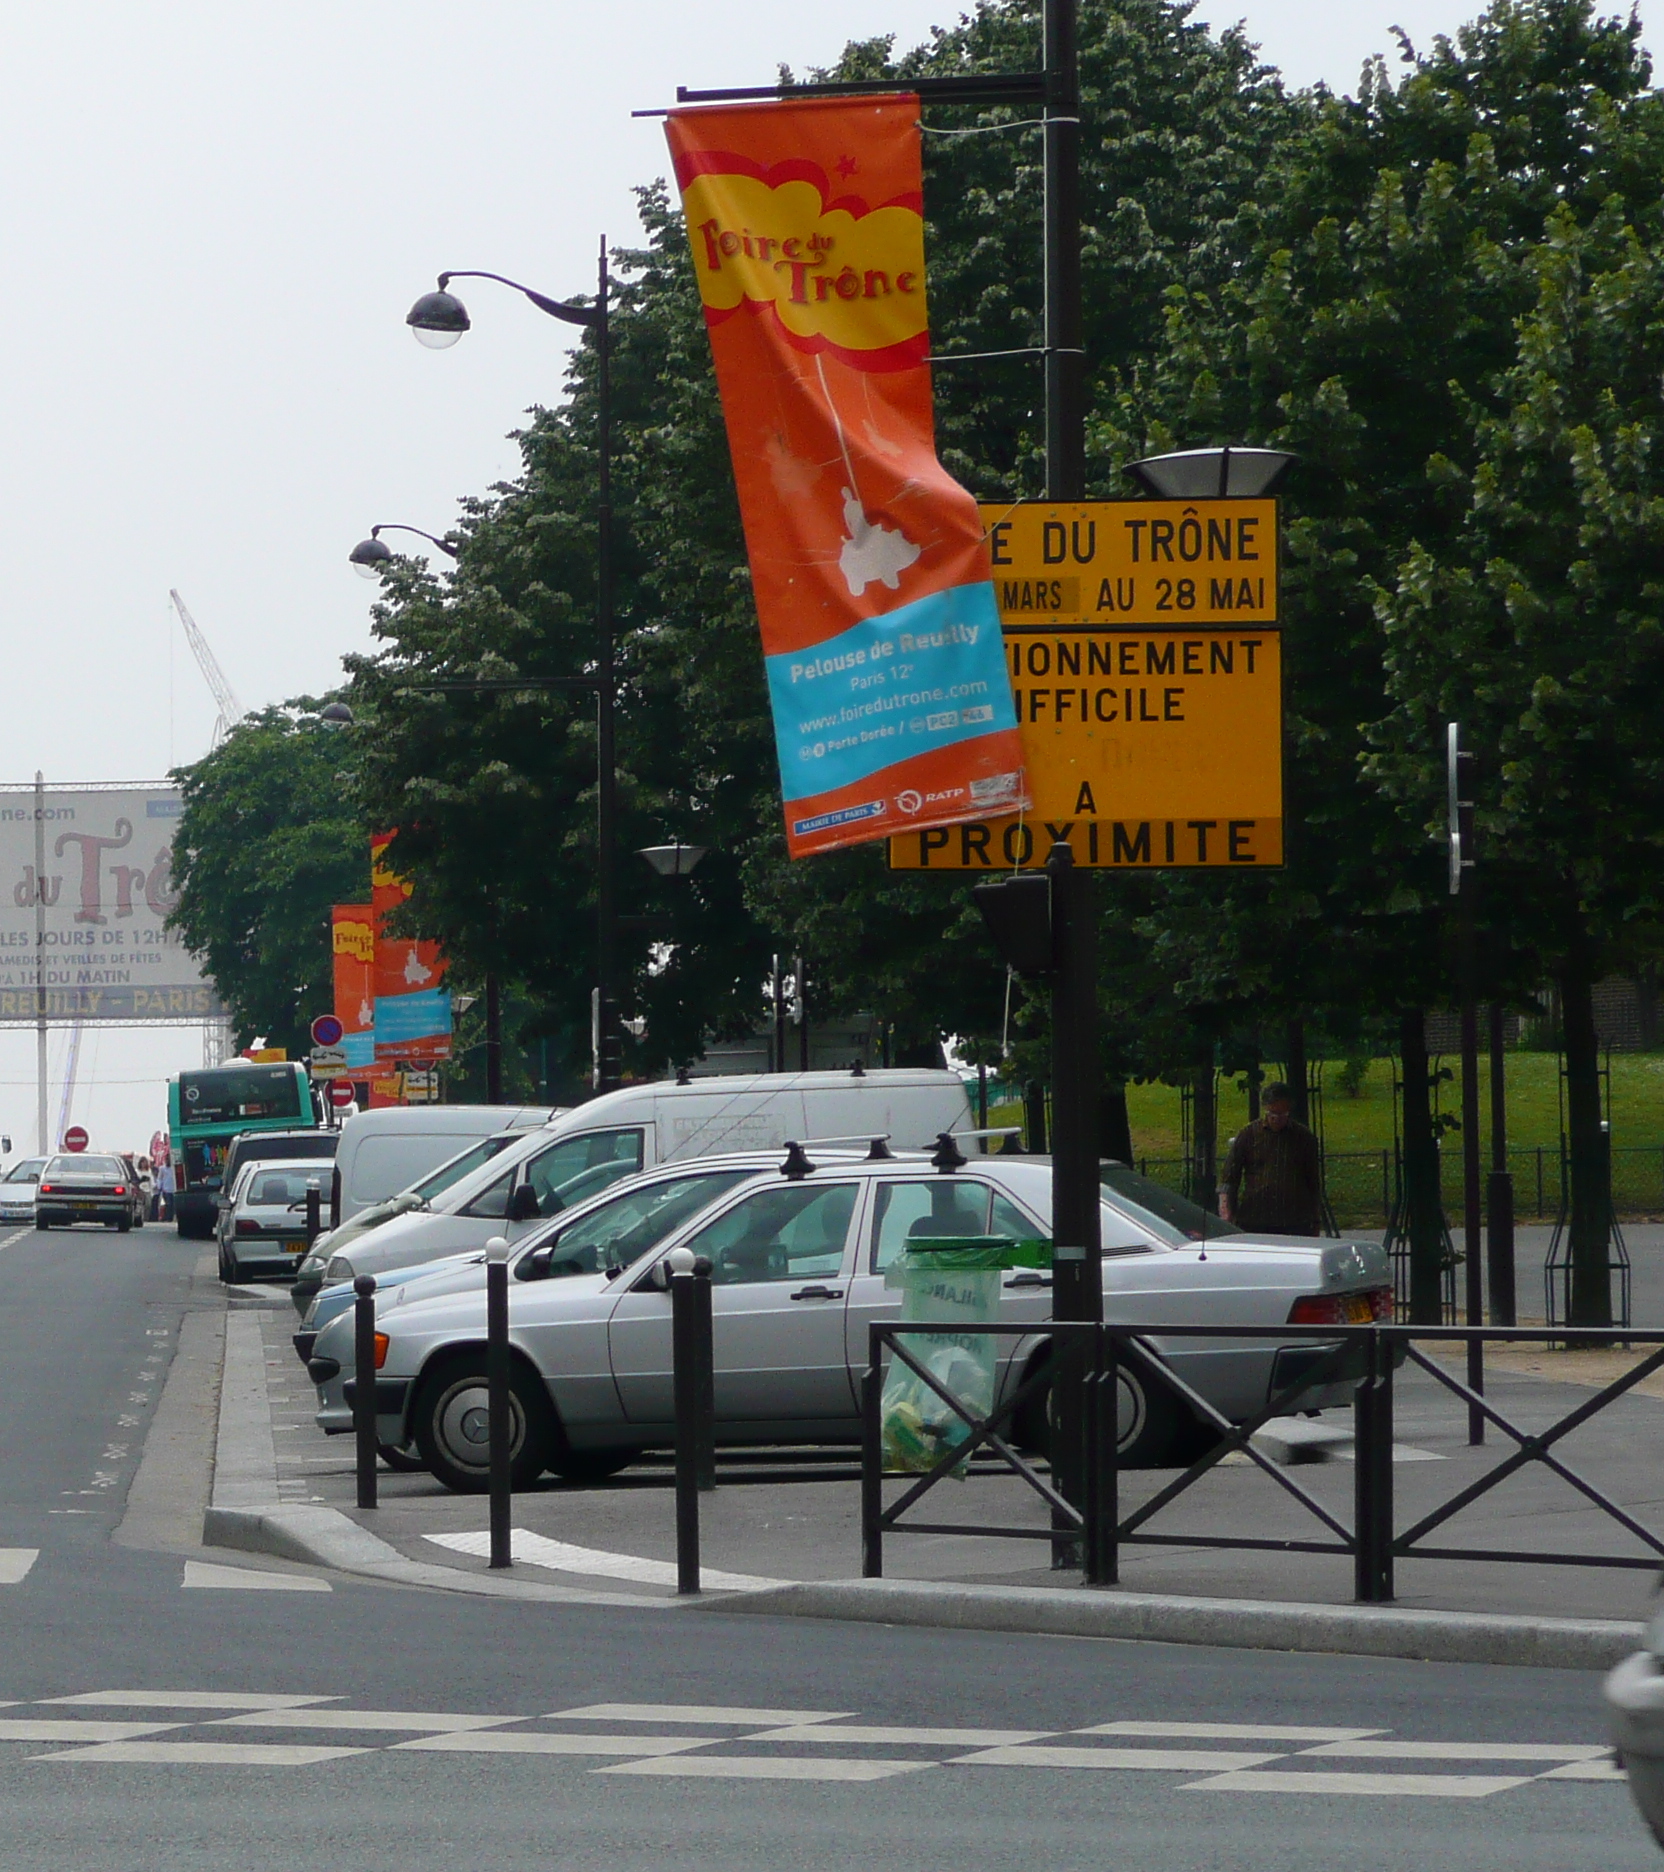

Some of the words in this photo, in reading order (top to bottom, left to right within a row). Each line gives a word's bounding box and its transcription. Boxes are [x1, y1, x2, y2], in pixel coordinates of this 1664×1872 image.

[697, 218, 800, 271] Foire
[806, 231, 834, 251] du
[773, 252, 915, 305] Trône
[984, 522, 1013, 565] E
[1042, 519, 1096, 565] DU
[1124, 507, 1259, 562] TRÔNE
[1003, 580, 1062, 611] MARS
[1096, 577, 1134, 611] AU
[1156, 577, 1196, 611] 28
[1209, 576, 1265, 610] MAI
[789, 648, 866, 684] Pelouse
[870, 640, 894, 661] de
[898, 623, 980, 653] Reuilly
[1004, 640, 1263, 677] IONNEMENT
[850, 672, 885, 691] Paris
[798, 679, 988, 734] www.foiredutrone.com
[828, 735, 859, 752] Porte
[925, 788, 964, 802] RATP
[1074, 781, 1097, 815] A
[802, 815, 830, 830] MAIRIE
[831, 813, 843, 824] DE
[845, 808, 869, 820] PARIS
[919, 820, 1257, 867] PROXIMITE
[13, 865, 64, 907] du
[0, 931, 29, 947] LES
[36, 930, 96, 946] JOURS
[101, 930, 124, 945] DE
[132, 929, 168, 944] 12H
[46, 954, 58, 965] ET
[63, 953, 106, 964] VEILLES
[110, 953, 126, 964] DE
[19, 970, 41, 985] 1H
[47, 970, 70, 984] DU
[77, 969, 131, 984] MATIN
[1, 988, 102, 1016] REUILLY
[132, 986, 211, 1013] PARIS
